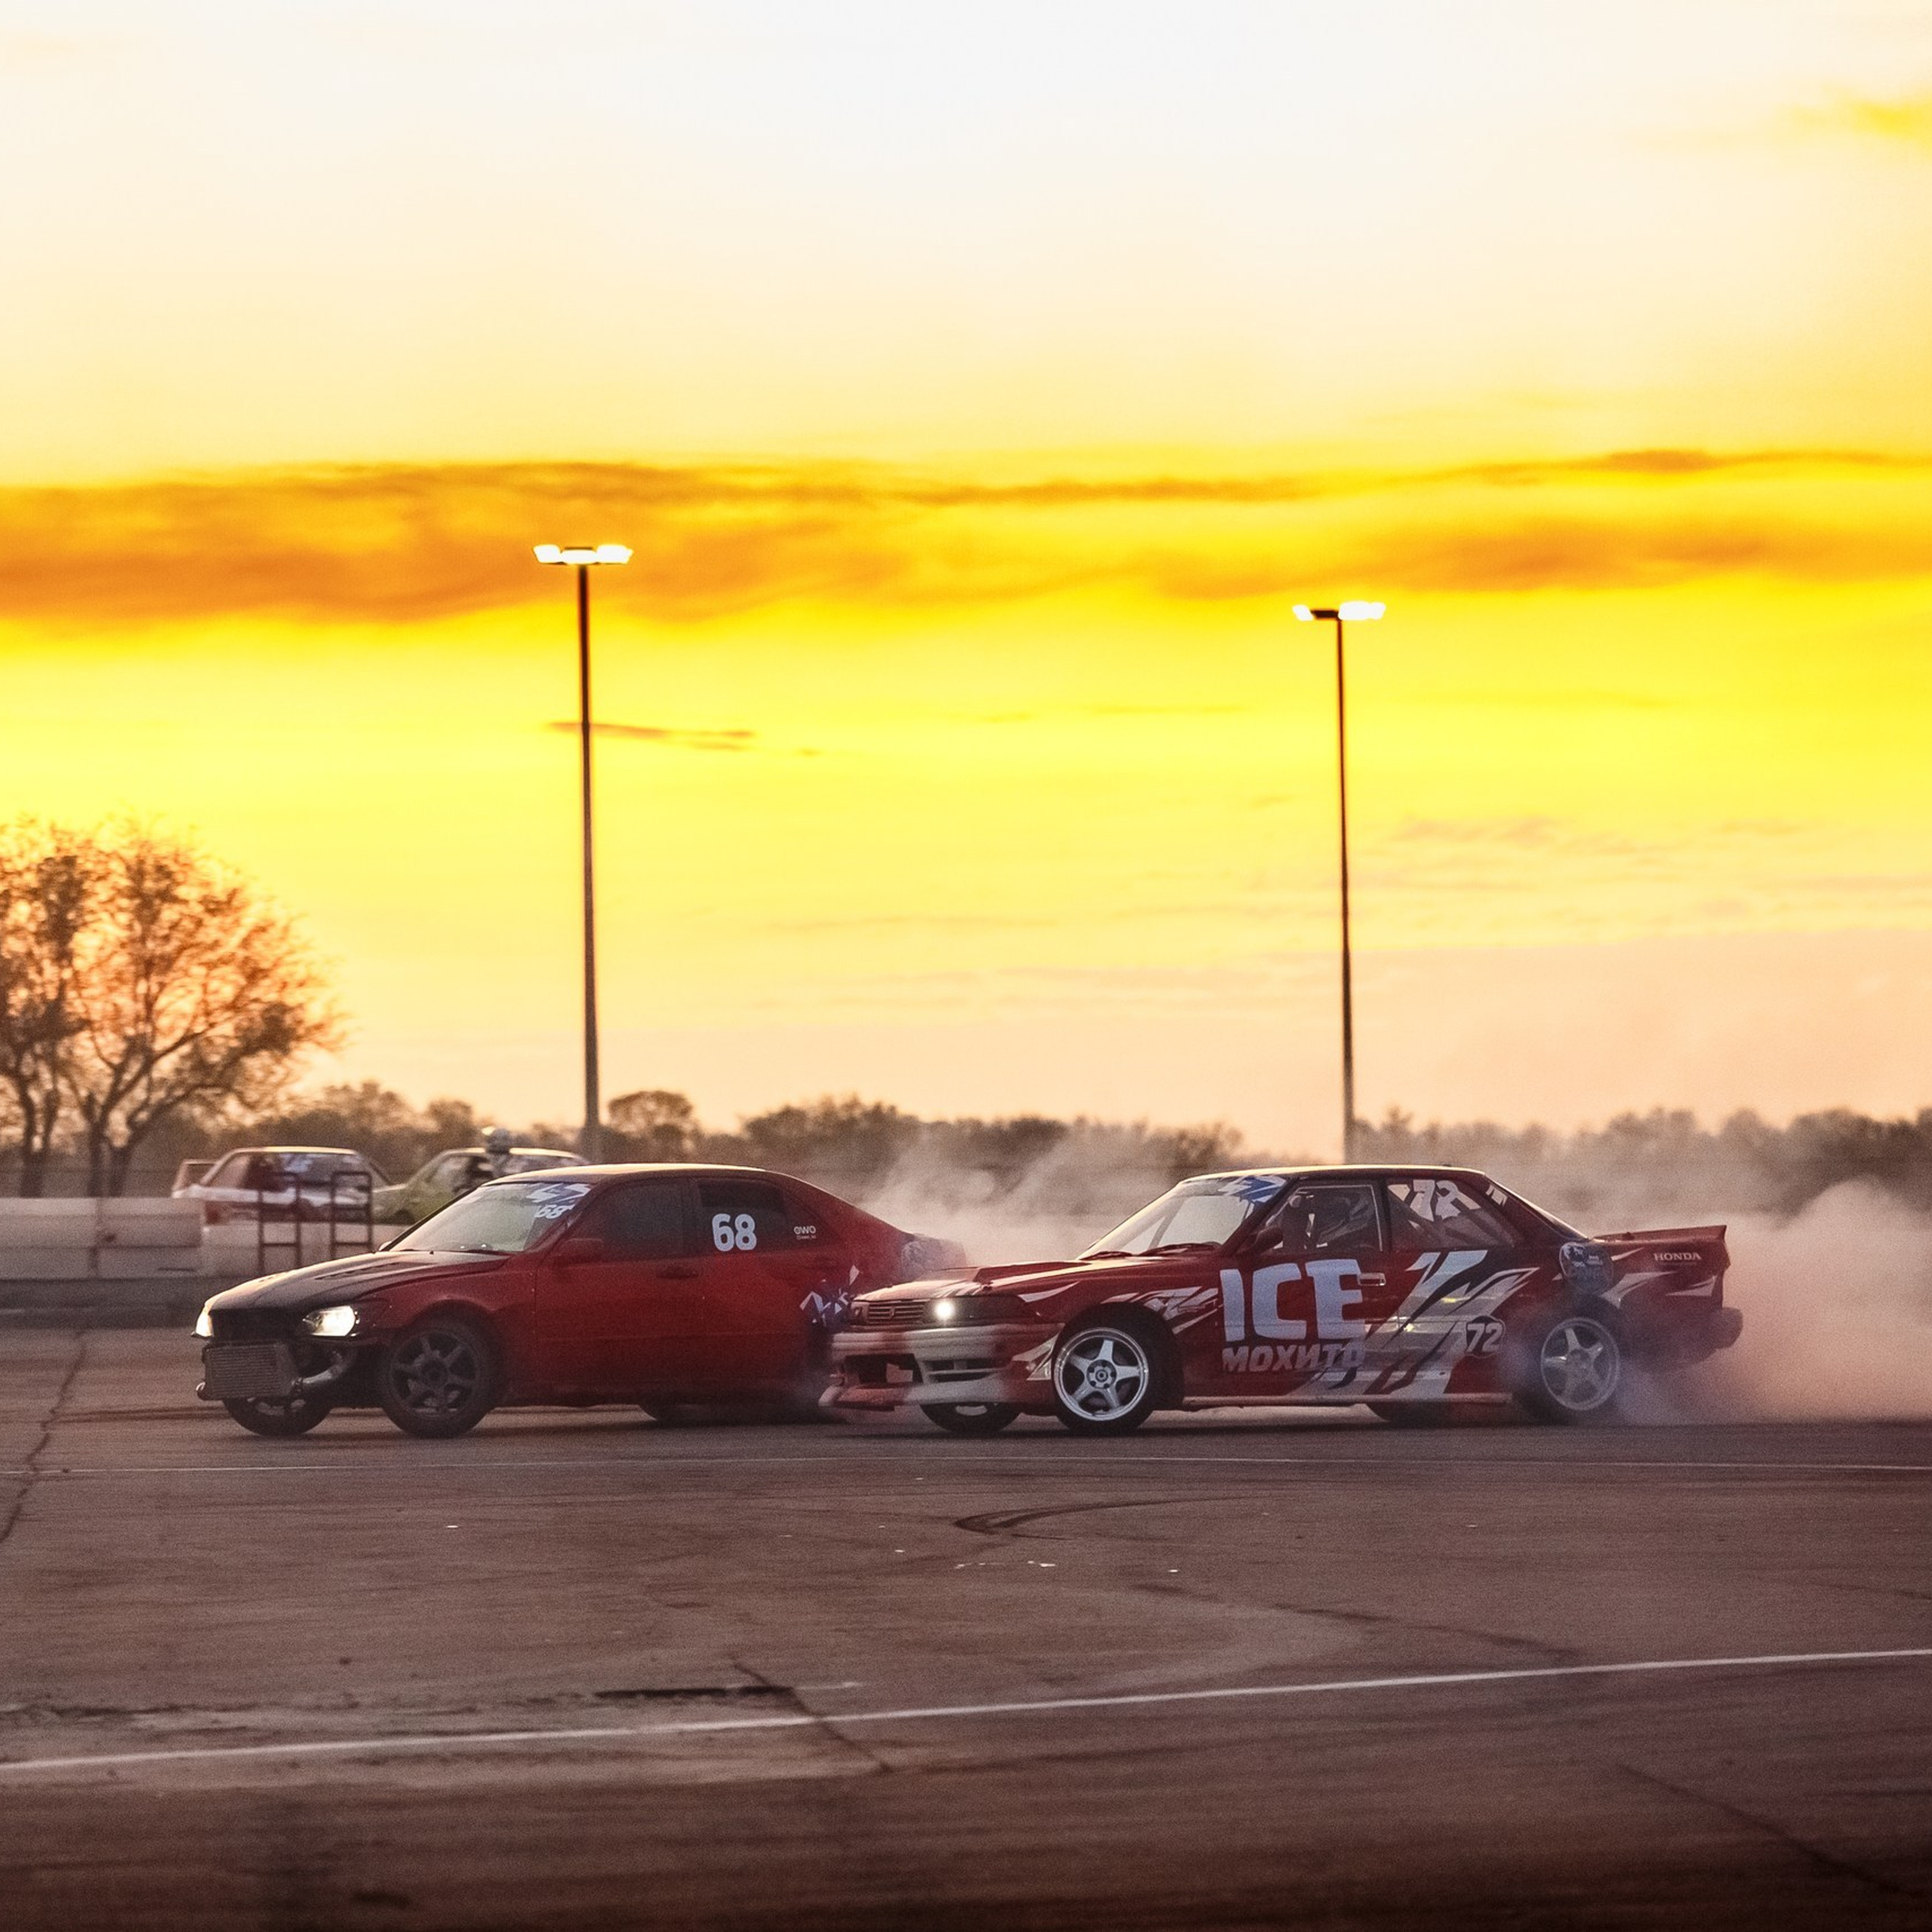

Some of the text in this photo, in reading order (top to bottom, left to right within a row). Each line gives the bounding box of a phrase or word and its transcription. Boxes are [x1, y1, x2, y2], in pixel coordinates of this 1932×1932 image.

[534, 1204, 571, 1220] 68
[712, 1214, 757, 1251] 68
[1654, 1252, 1701, 1261] HONDA
[1220, 1259, 1365, 1342] ICE
[1467, 1323, 1503, 1352] 72
[1222, 1340, 1364, 1372] МОХИТО
